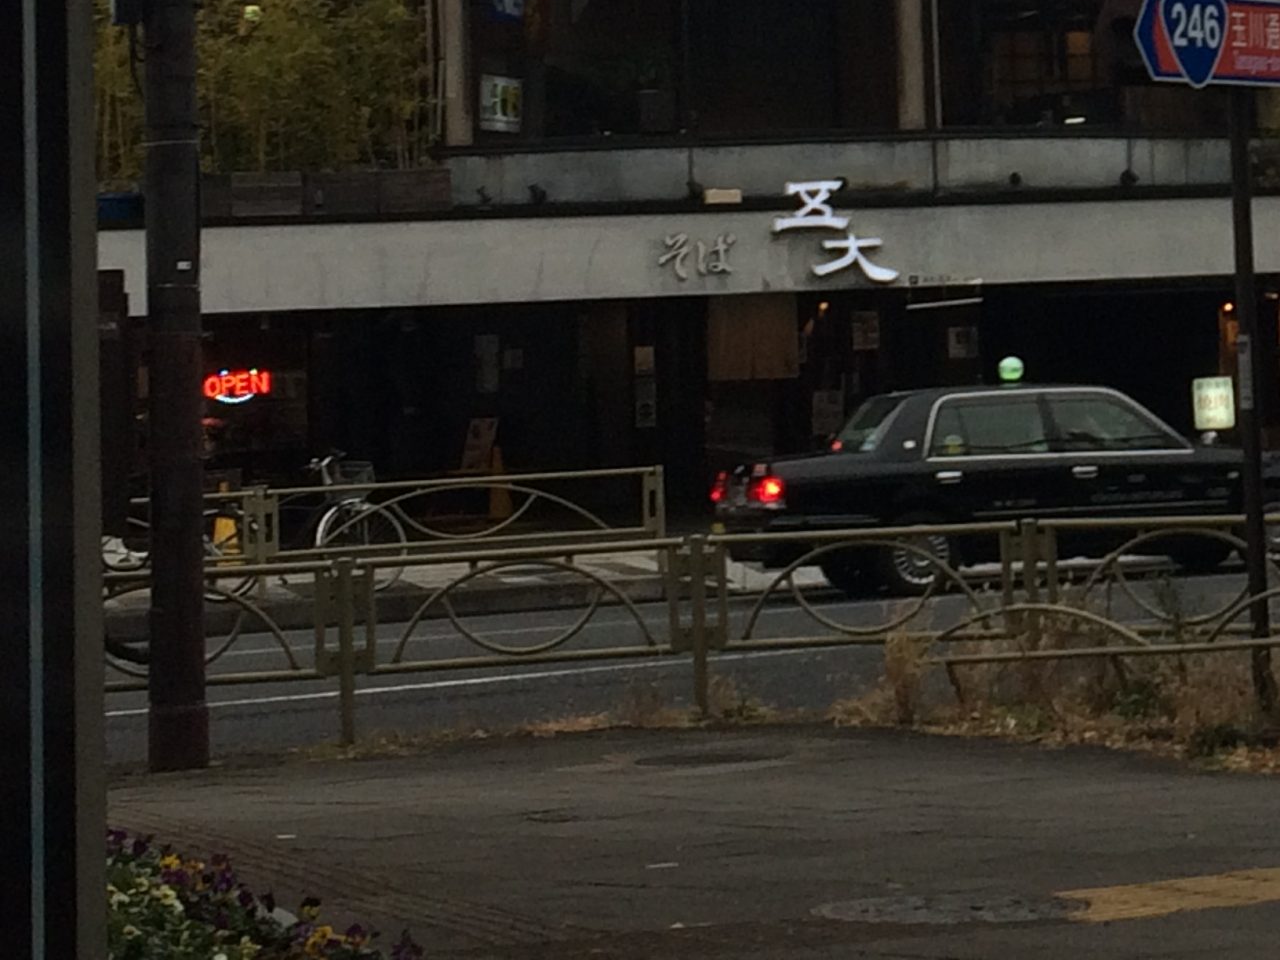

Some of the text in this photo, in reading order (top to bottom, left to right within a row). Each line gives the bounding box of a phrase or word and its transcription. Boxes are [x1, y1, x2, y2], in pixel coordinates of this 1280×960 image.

[1171, 2, 1221, 49] 246
[658, 179, 900, 283] そば 五大
[203, 371, 270, 399] OPEN
